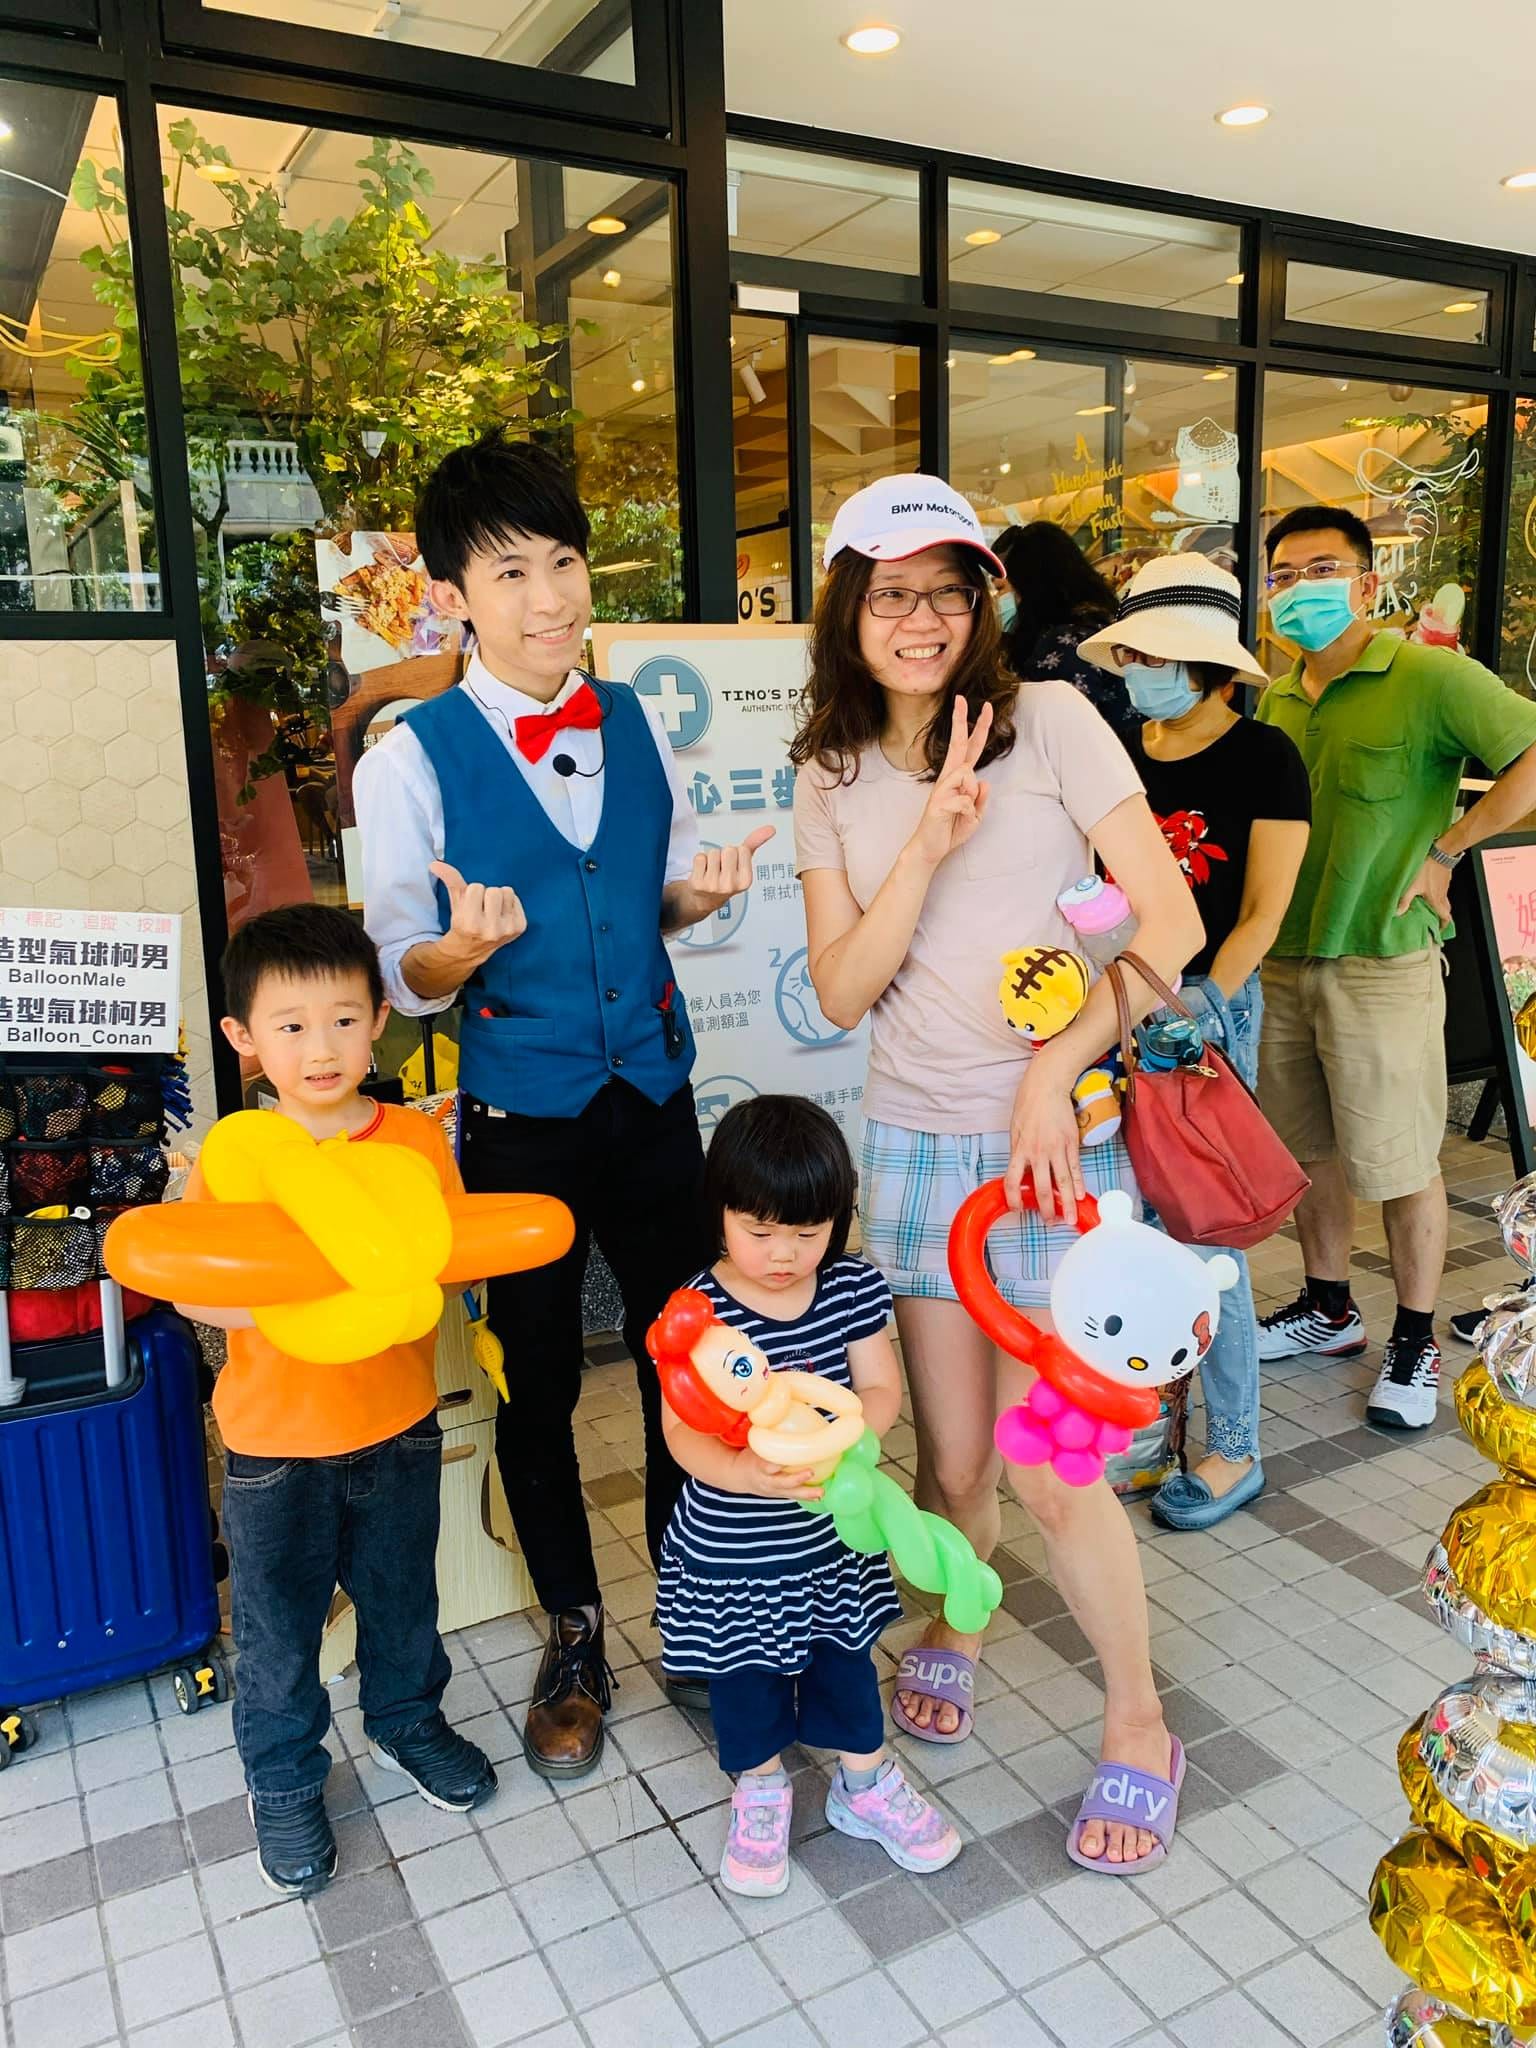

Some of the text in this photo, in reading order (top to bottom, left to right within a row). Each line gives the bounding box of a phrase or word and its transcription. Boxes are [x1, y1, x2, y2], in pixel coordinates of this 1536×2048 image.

[891, 503, 923, 514] BMW
[739, 586, 776, 620] O'S
[721, 689, 782, 701] TINO'S
[741, 704, 783, 713] AUTHENTIC
[768, 948, 783, 968] 2
[8, 968, 126, 988] BalloonMale
[687, 989, 761, 1014] 候人員為您
[7, 1027, 152, 1047] Balloon_Conan
[897, 1655, 975, 1693] Supe
